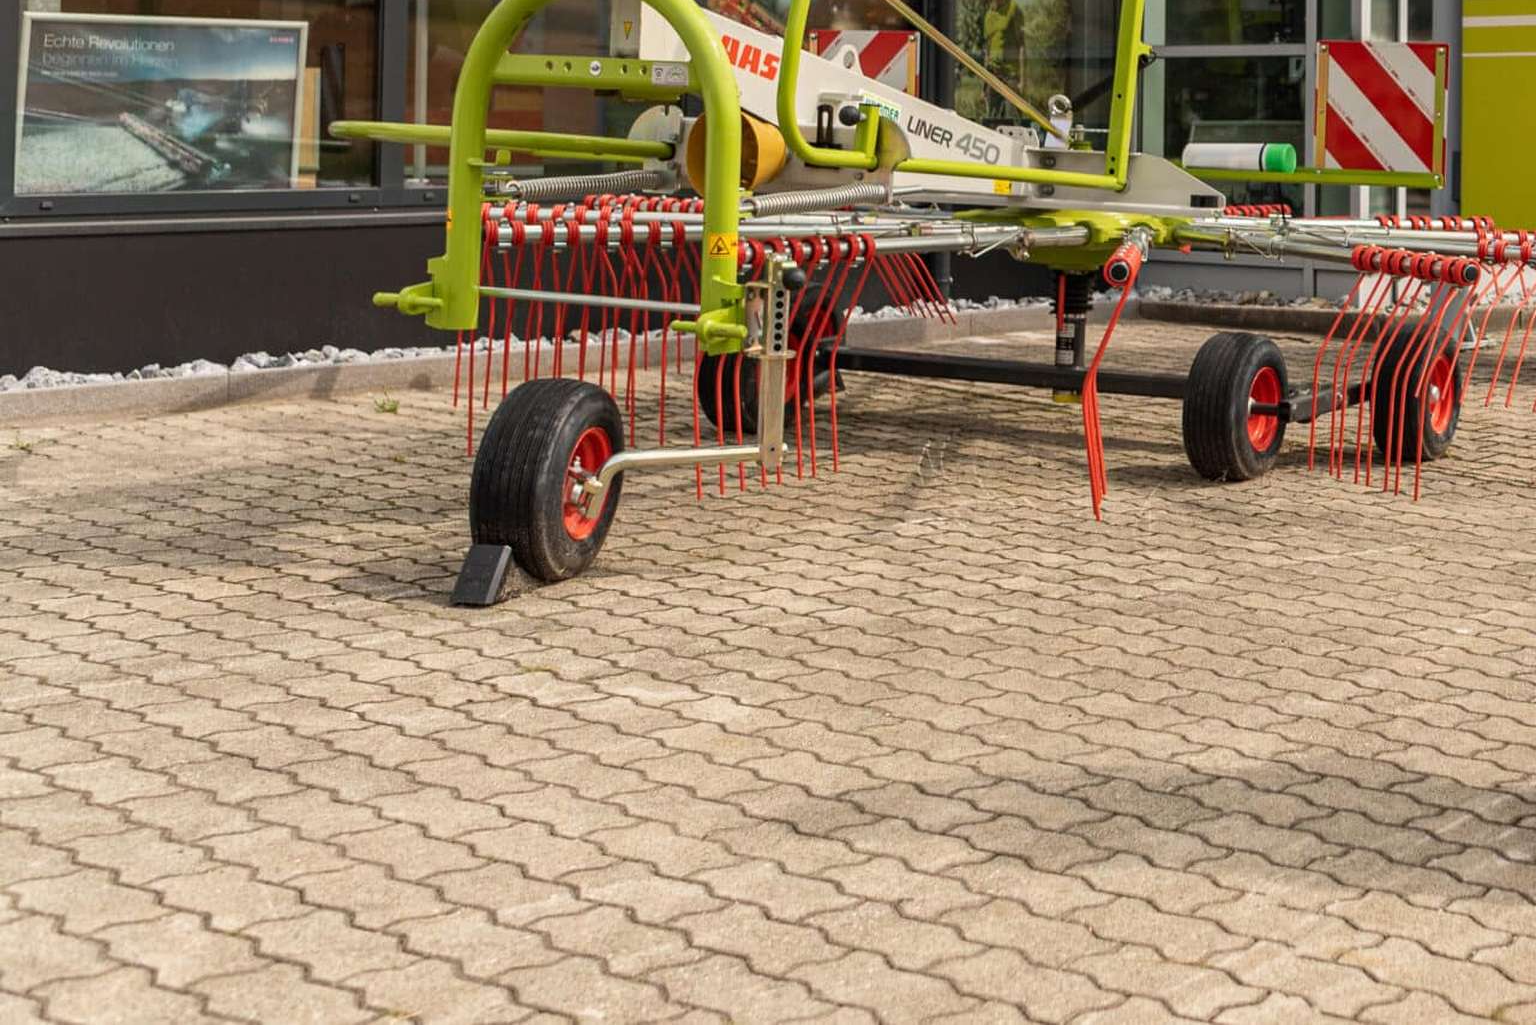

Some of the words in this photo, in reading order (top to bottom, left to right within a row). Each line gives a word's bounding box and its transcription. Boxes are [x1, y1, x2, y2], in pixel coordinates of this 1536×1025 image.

[43, 33, 85, 48] Echte
[88, 34, 175, 51] Revolutionen
[721, 34, 780, 81] AAS
[907, 115, 953, 148] LINER
[956, 133, 1001, 165] 450
